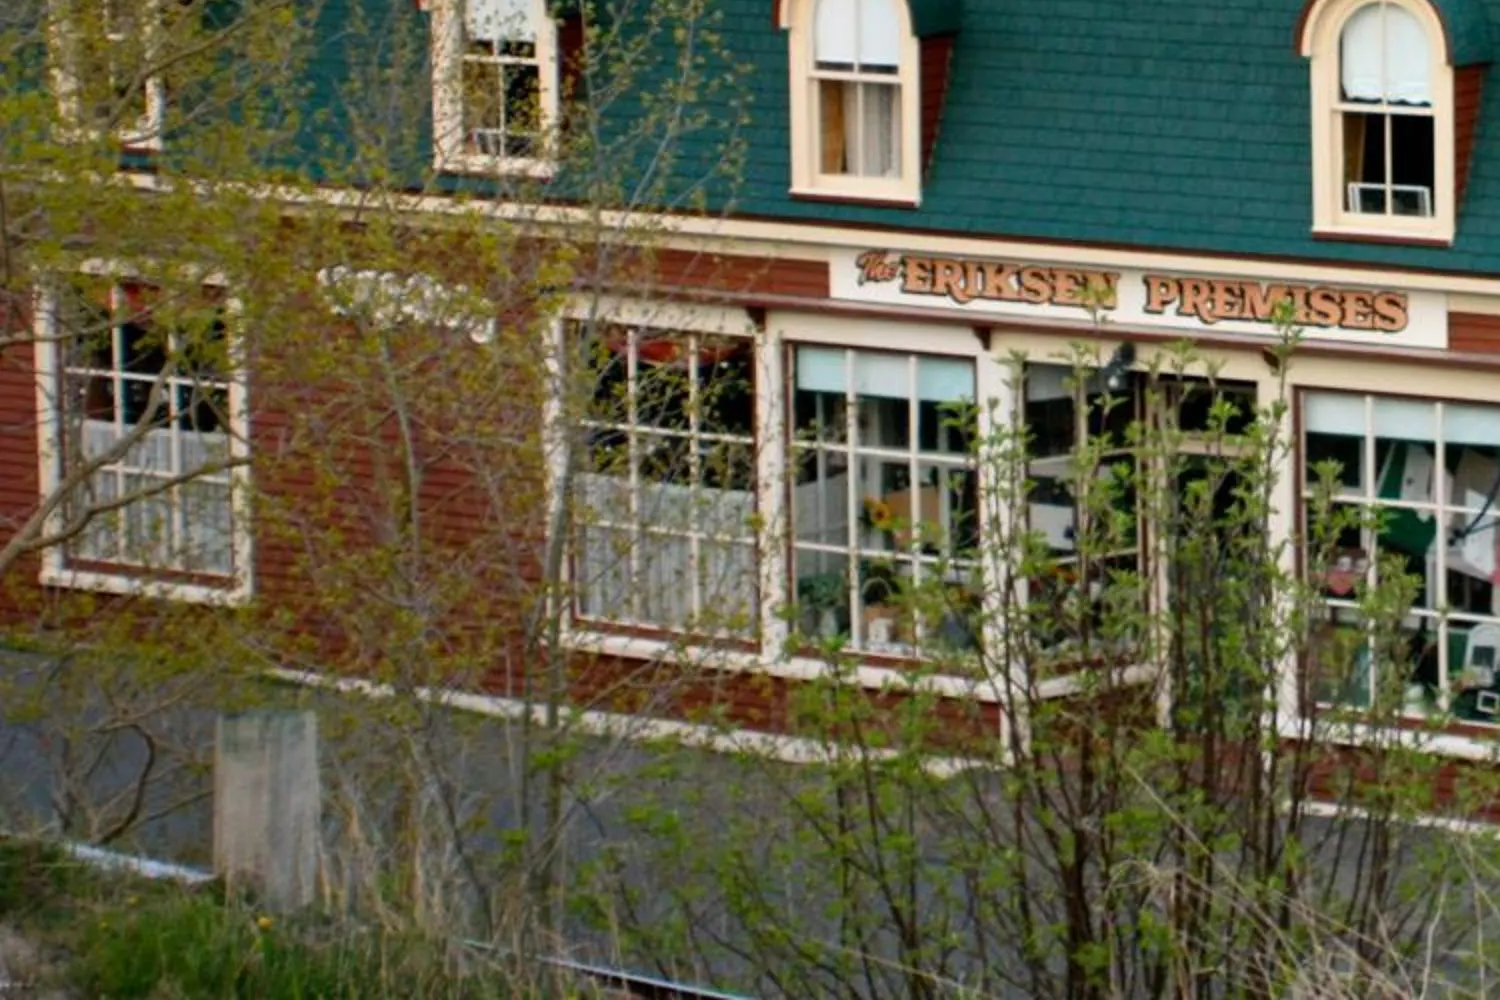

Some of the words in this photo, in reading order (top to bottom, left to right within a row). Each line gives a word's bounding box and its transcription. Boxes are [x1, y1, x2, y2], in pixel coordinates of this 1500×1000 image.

[856, 250, 899, 286] The
[900, 255, 1121, 309] ERIKSEN
[1143, 275, 1408, 332] PREMISES
